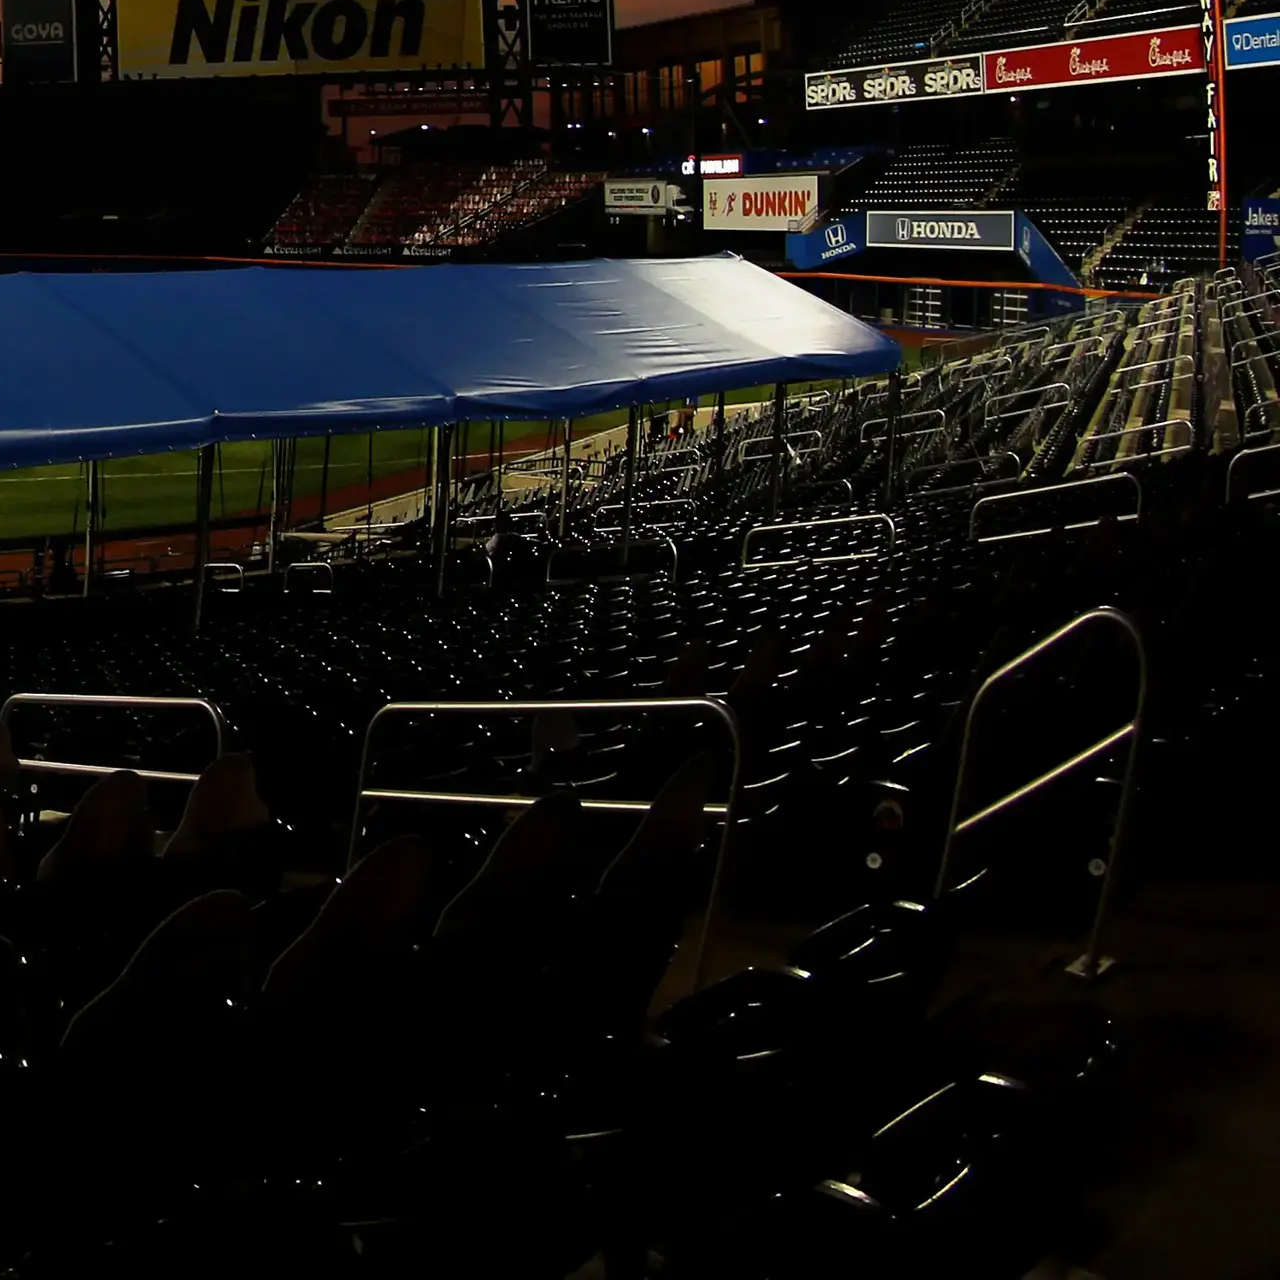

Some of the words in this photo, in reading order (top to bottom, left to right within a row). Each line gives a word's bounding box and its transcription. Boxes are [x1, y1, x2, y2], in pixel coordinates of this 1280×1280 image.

[11, 22, 64, 41] GOYA
[742, 190, 810, 217] DUNKIN'
[912, 222, 982, 239] HONDA
[432, 248, 451, 256] LIGHT
[821, 242, 857, 260] HONDA
